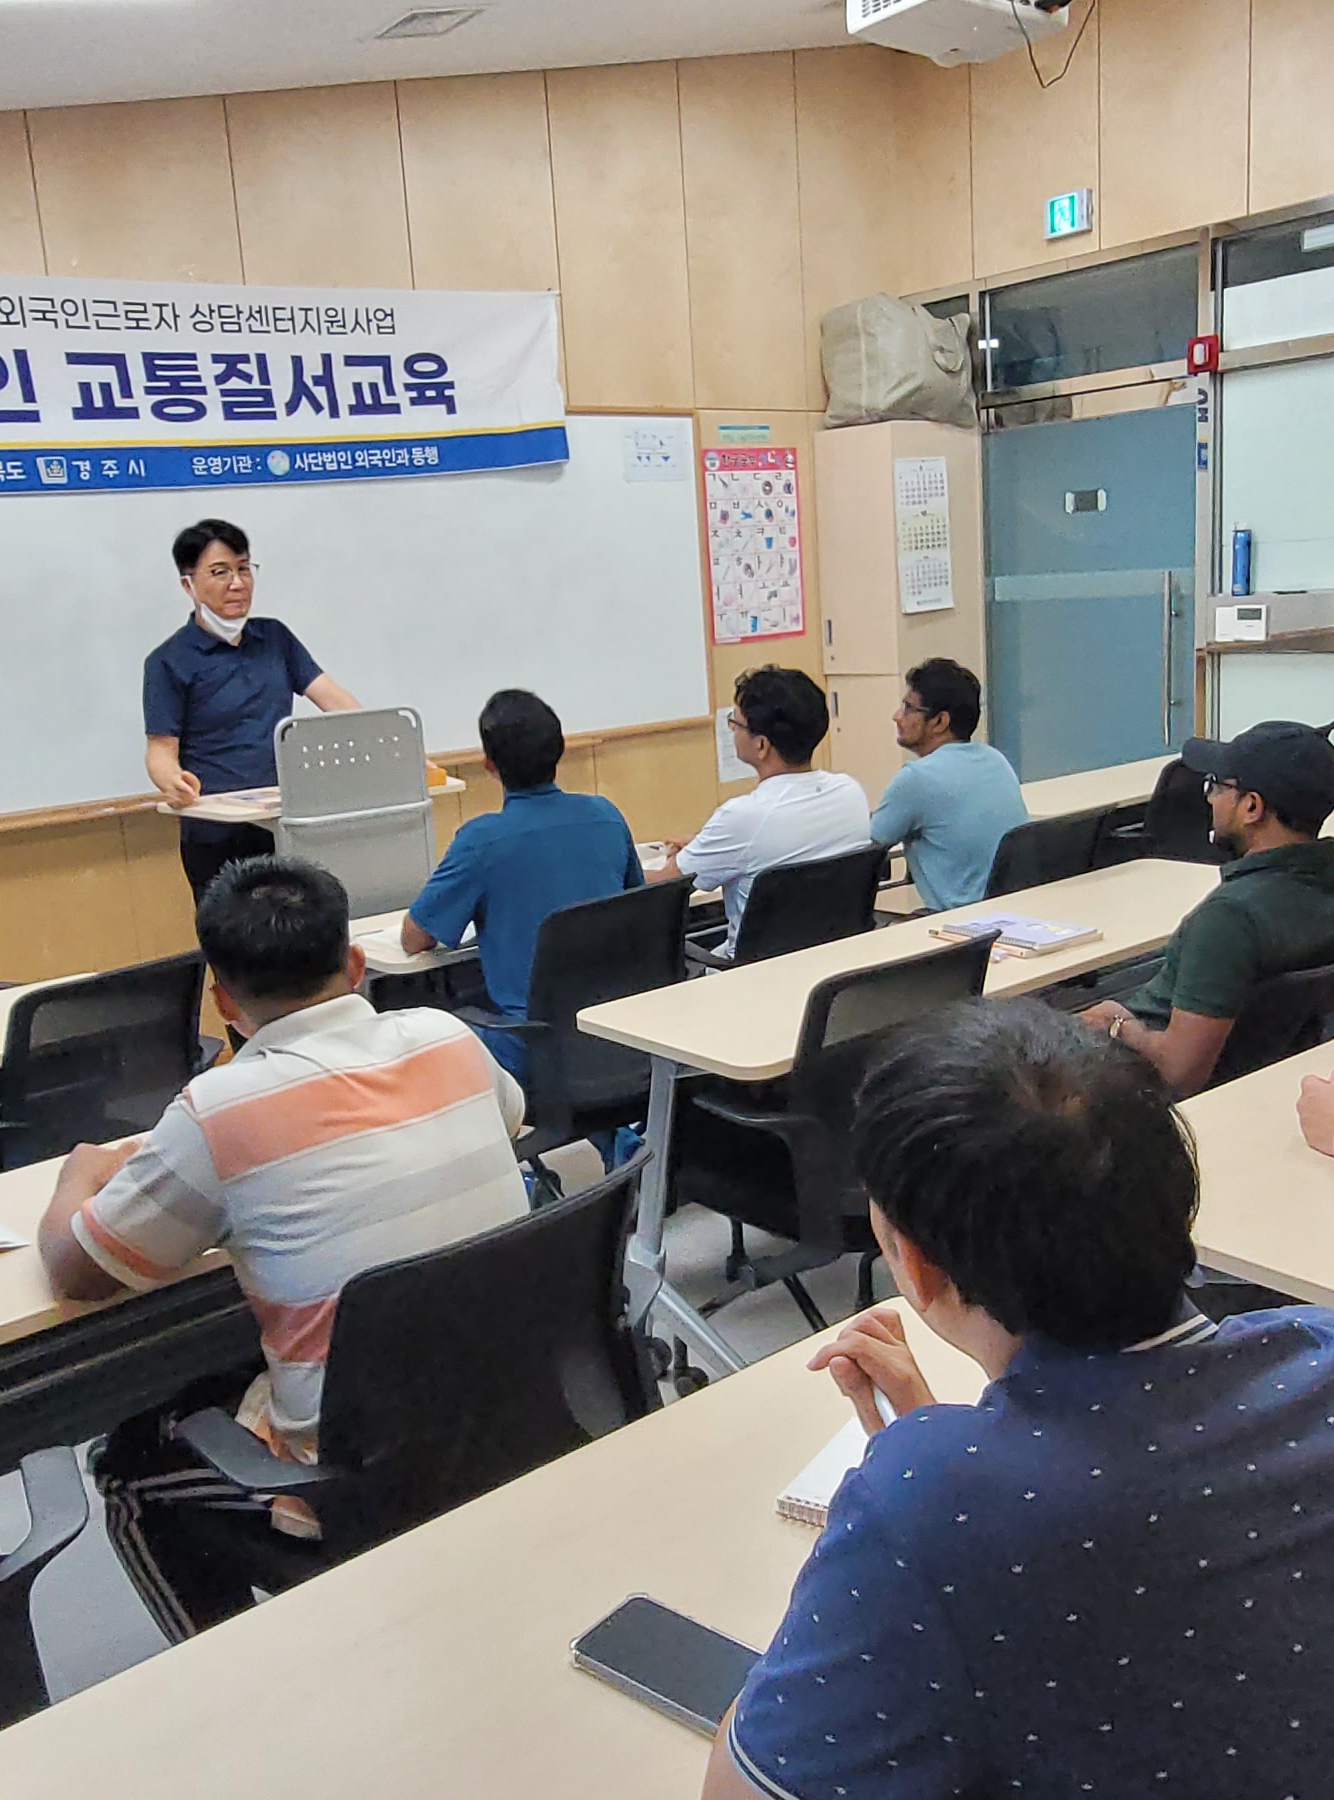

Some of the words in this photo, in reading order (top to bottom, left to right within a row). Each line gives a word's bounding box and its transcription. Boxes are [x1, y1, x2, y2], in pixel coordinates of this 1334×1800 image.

[189, 302, 396, 336] 상담센터지원사업
[64, 351, 458, 423] 교통질서교육
[294, 452, 353, 472] 사단법인
[354, 449, 410, 469] 외국인과
[411, 446, 440, 465] 동행
